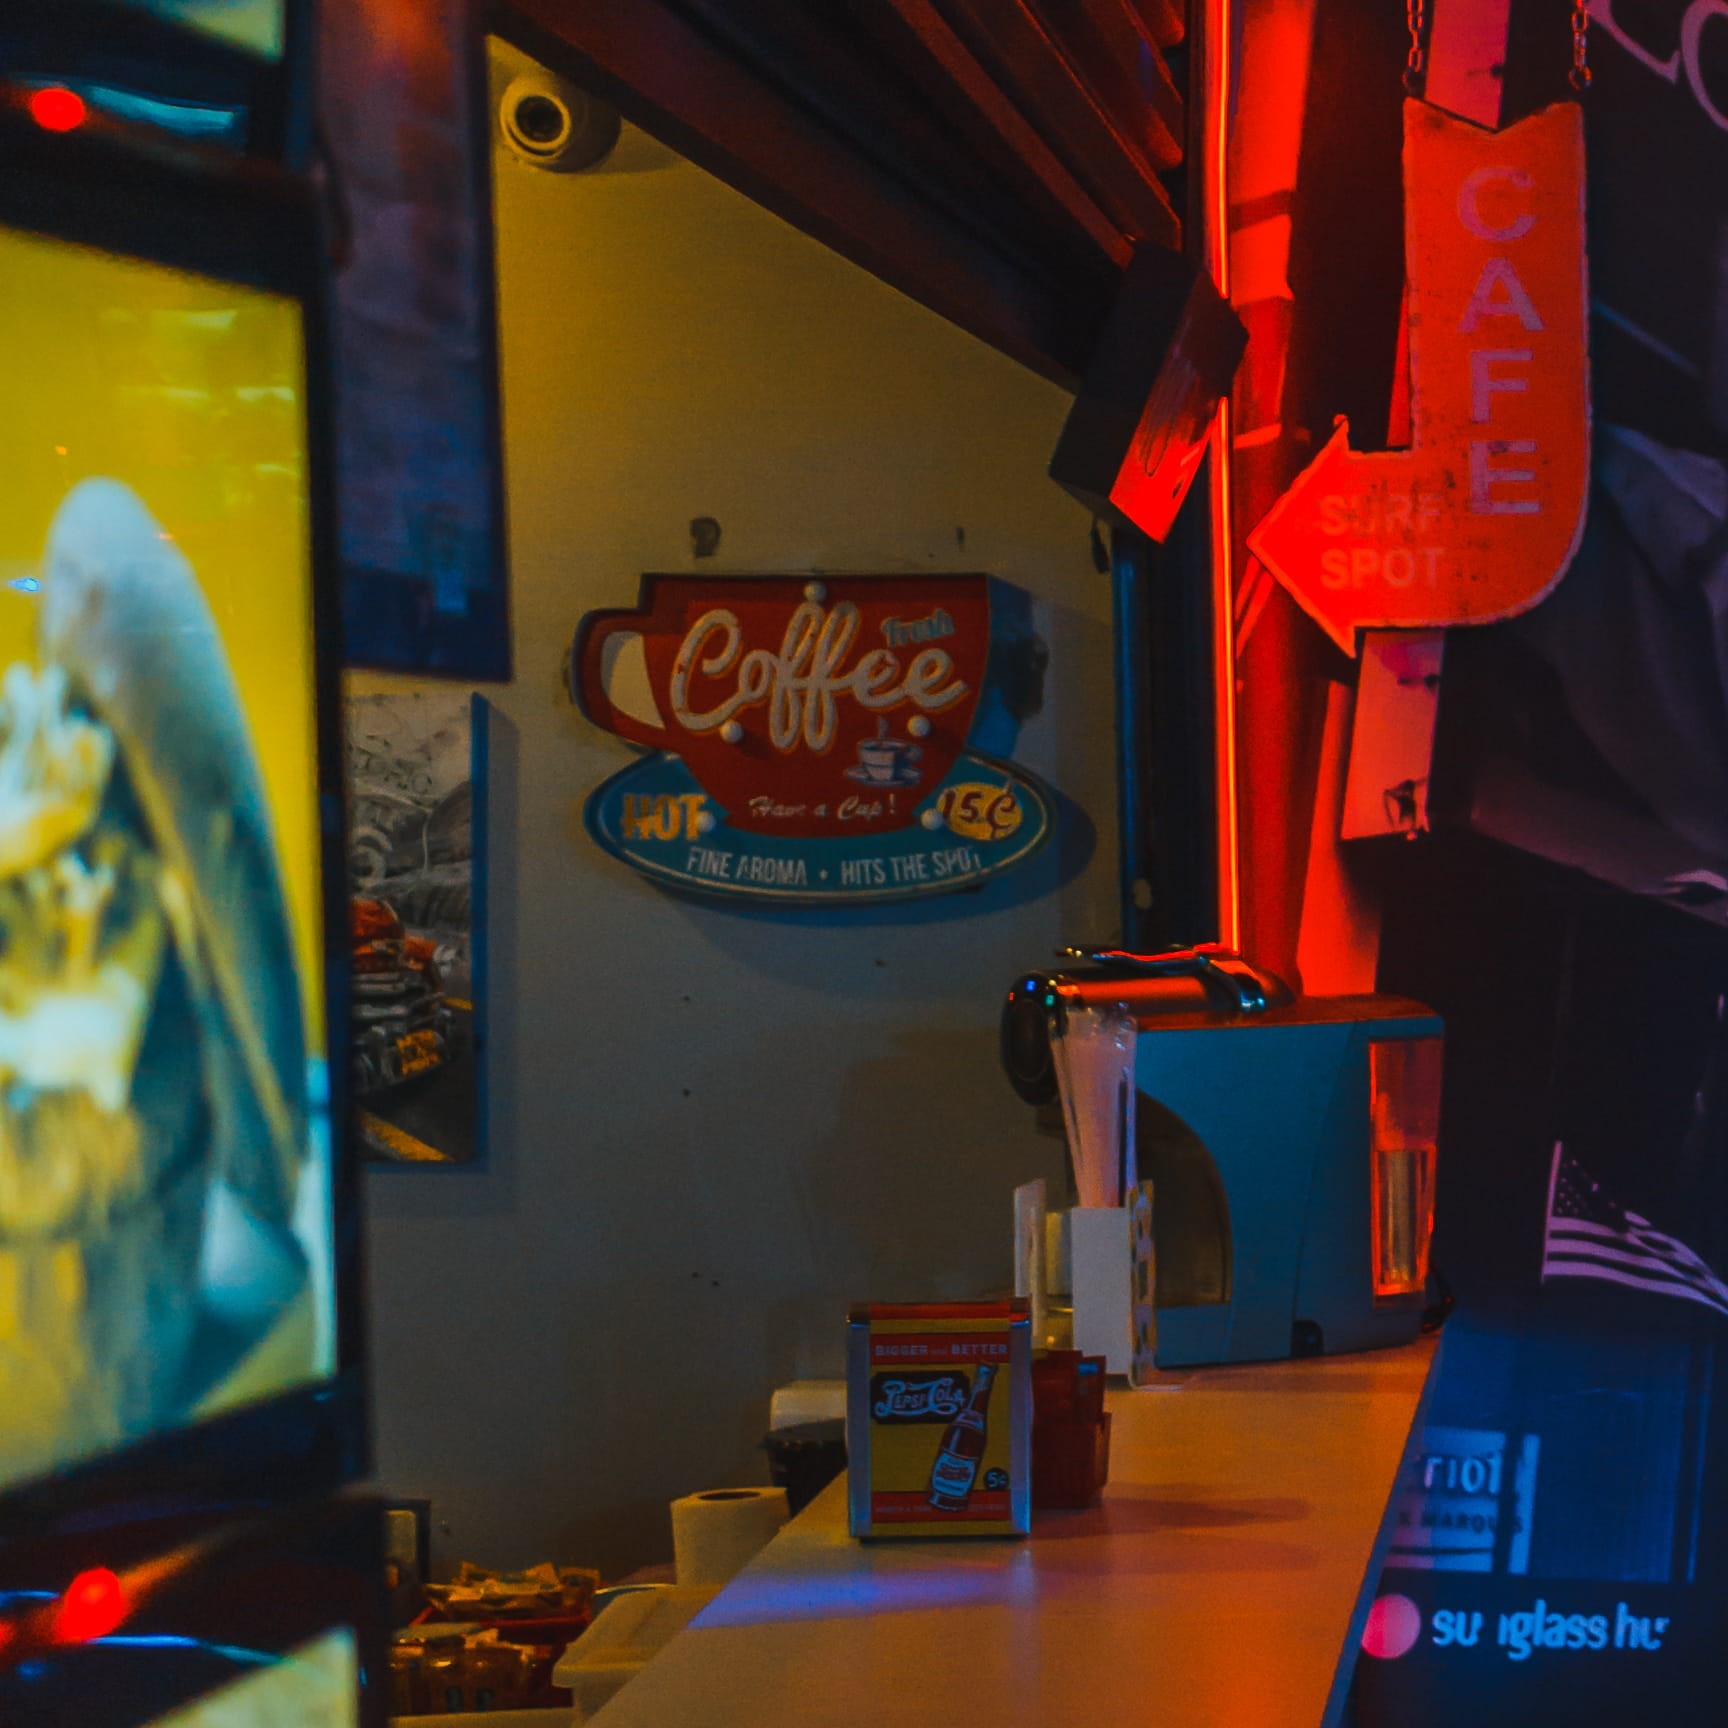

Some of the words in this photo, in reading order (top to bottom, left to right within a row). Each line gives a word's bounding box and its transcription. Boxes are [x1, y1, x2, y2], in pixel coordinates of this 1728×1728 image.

[1455, 165, 1546, 516] CAFE
[1317, 492, 1447, 536] SURF
[1318, 546, 1446, 591] SPOT
[669, 601, 970, 752] Coffee
[621, 791, 706, 841] HOT
[813, 803, 829, 818] a
[686, 846, 734, 877] FINE
[736, 854, 809, 886] AROMA
[839, 858, 886, 885] HITS
[890, 851, 926, 882] THE
[874, 1344, 929, 1357] BIGGER
[951, 1343, 1008, 1356] BETTER
